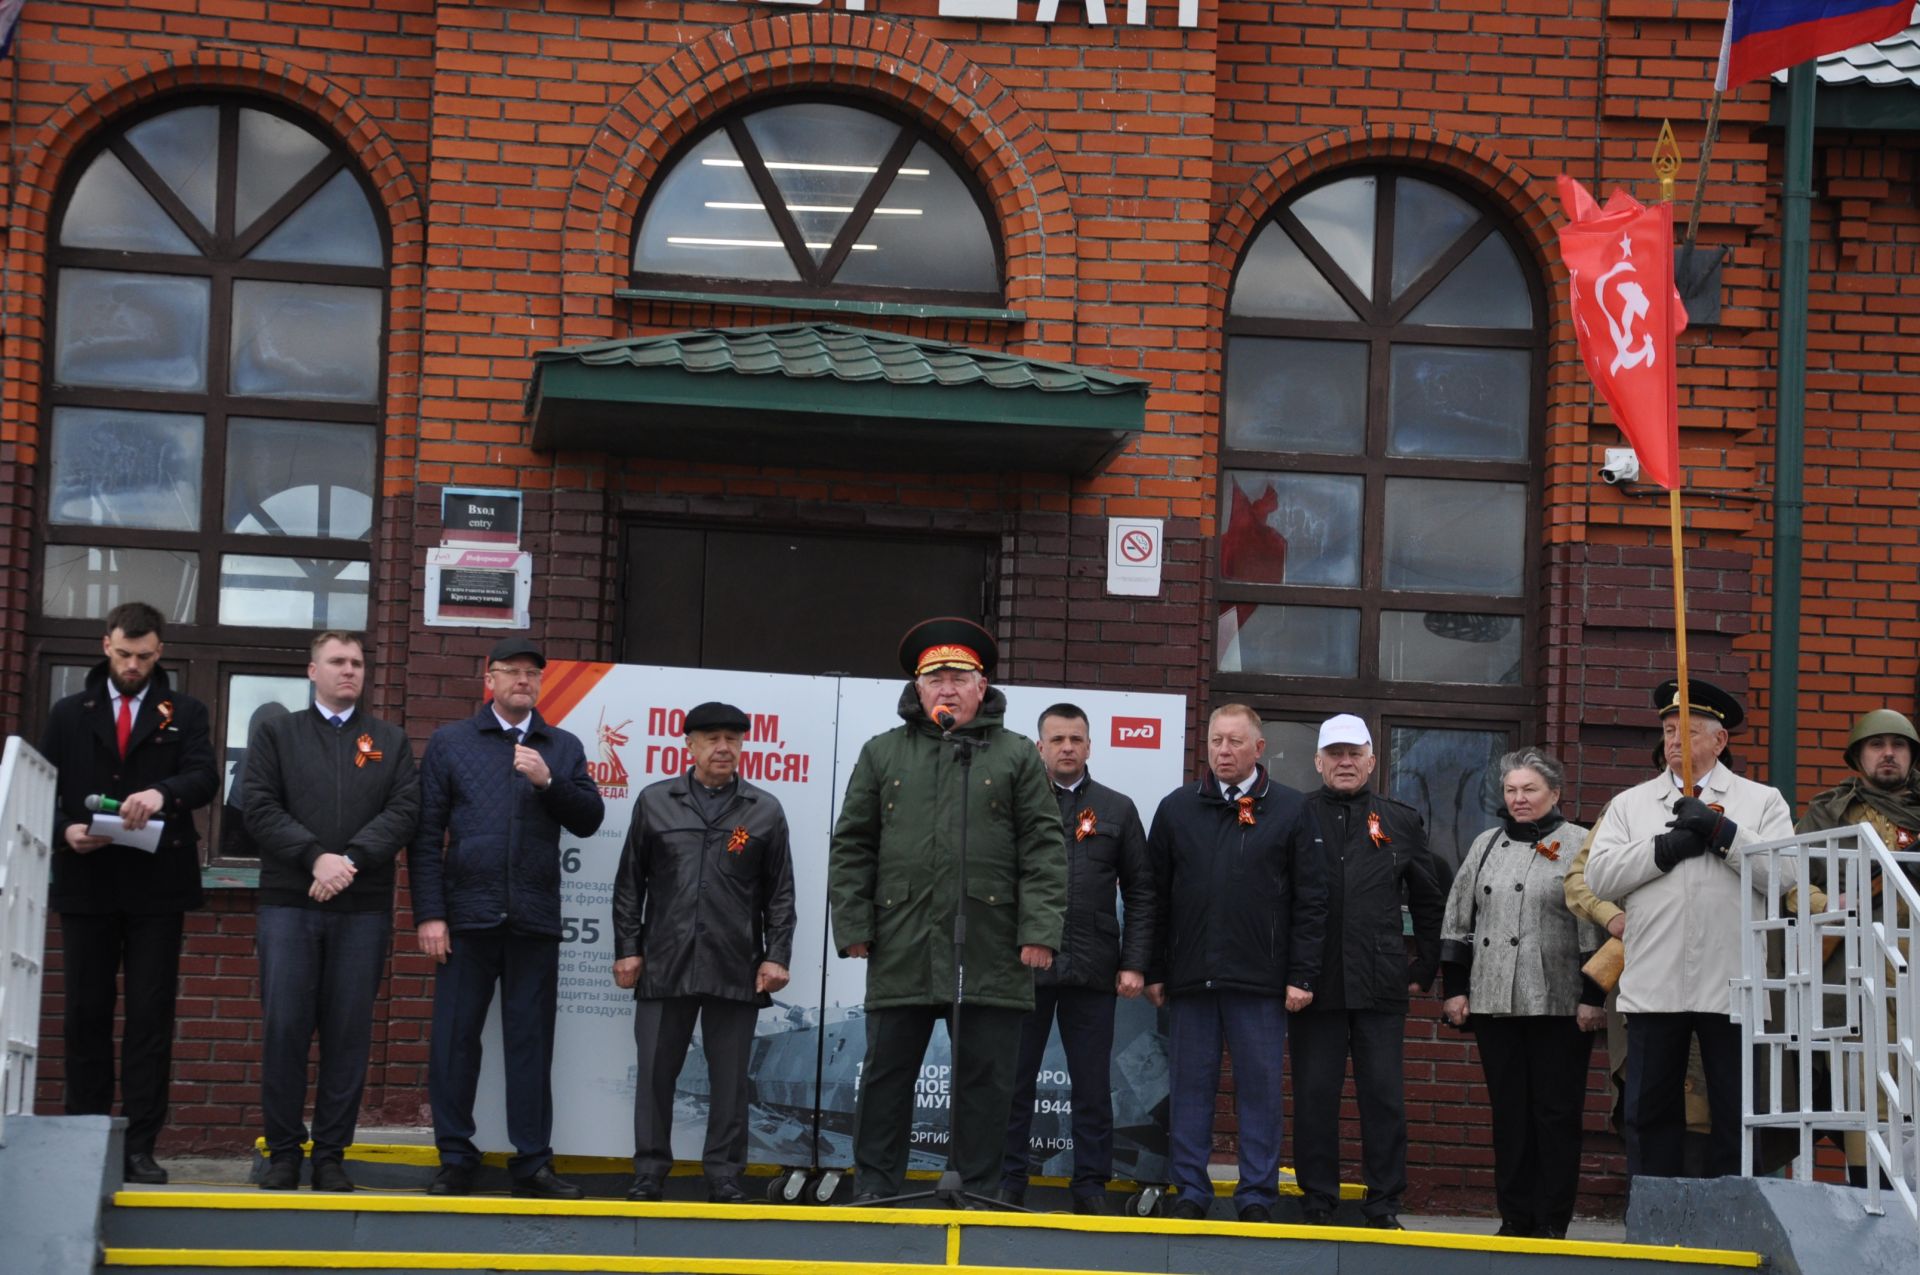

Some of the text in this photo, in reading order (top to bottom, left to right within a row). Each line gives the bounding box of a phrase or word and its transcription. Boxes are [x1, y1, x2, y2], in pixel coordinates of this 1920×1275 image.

[468, 504, 495, 516] Вход
[468, 519, 493, 529] entry
[648, 707, 786, 749] ПОМ,
[645, 745, 809, 783] ГОРМСЯ!
[560, 880, 614, 893] епоездо
[576, 893, 613, 906] фрон
[559, 963, 575, 972] ов
[559, 977, 611, 987] довано
[558, 991, 599, 1001] щиты
[576, 1005, 632, 1017] воздуха
[915, 1079, 949, 1094] ПОЕ
[910, 1131, 949, 1144] ОРГИЙ
[1047, 1138, 1074, 1150] НОВ
